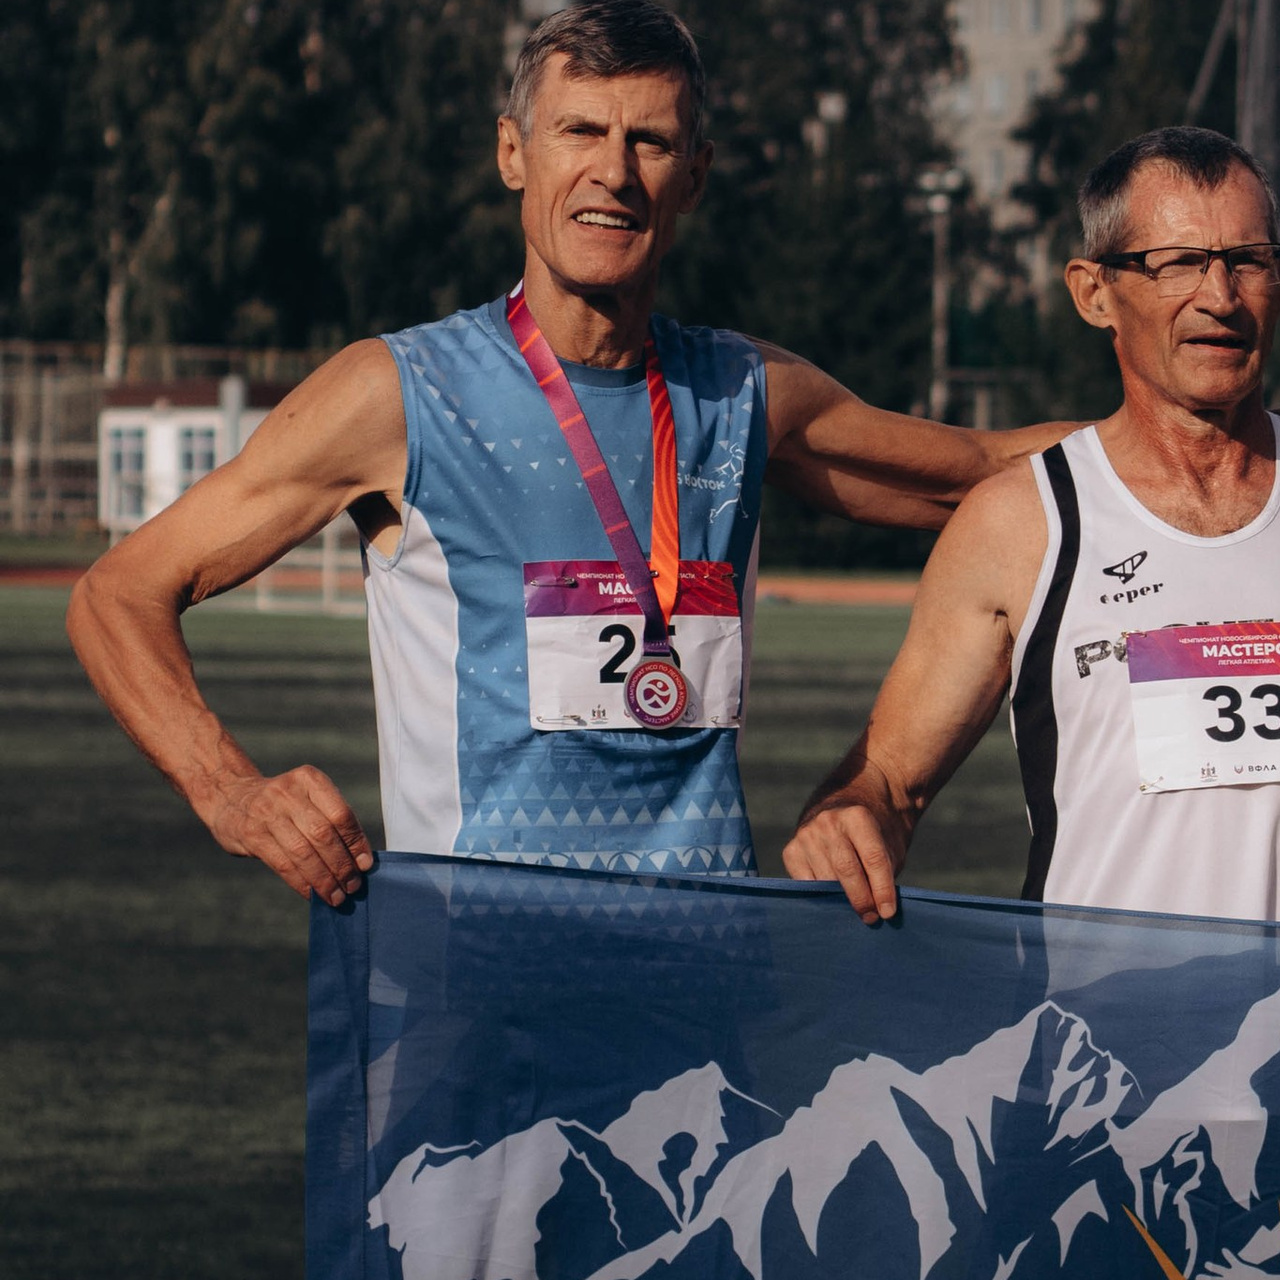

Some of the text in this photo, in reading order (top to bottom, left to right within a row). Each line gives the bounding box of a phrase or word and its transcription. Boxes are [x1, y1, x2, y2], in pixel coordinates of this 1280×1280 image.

[1179, 636, 1220, 644] ЧЕМПИОНАТ
[1220, 633, 1278, 642] НОВОСИБИРСКОЙ
[1218, 657, 1276, 666] ЛЕГКАЯ АТЛЕТИКА
[1248, 764, 1277, 772] ВФЛА
